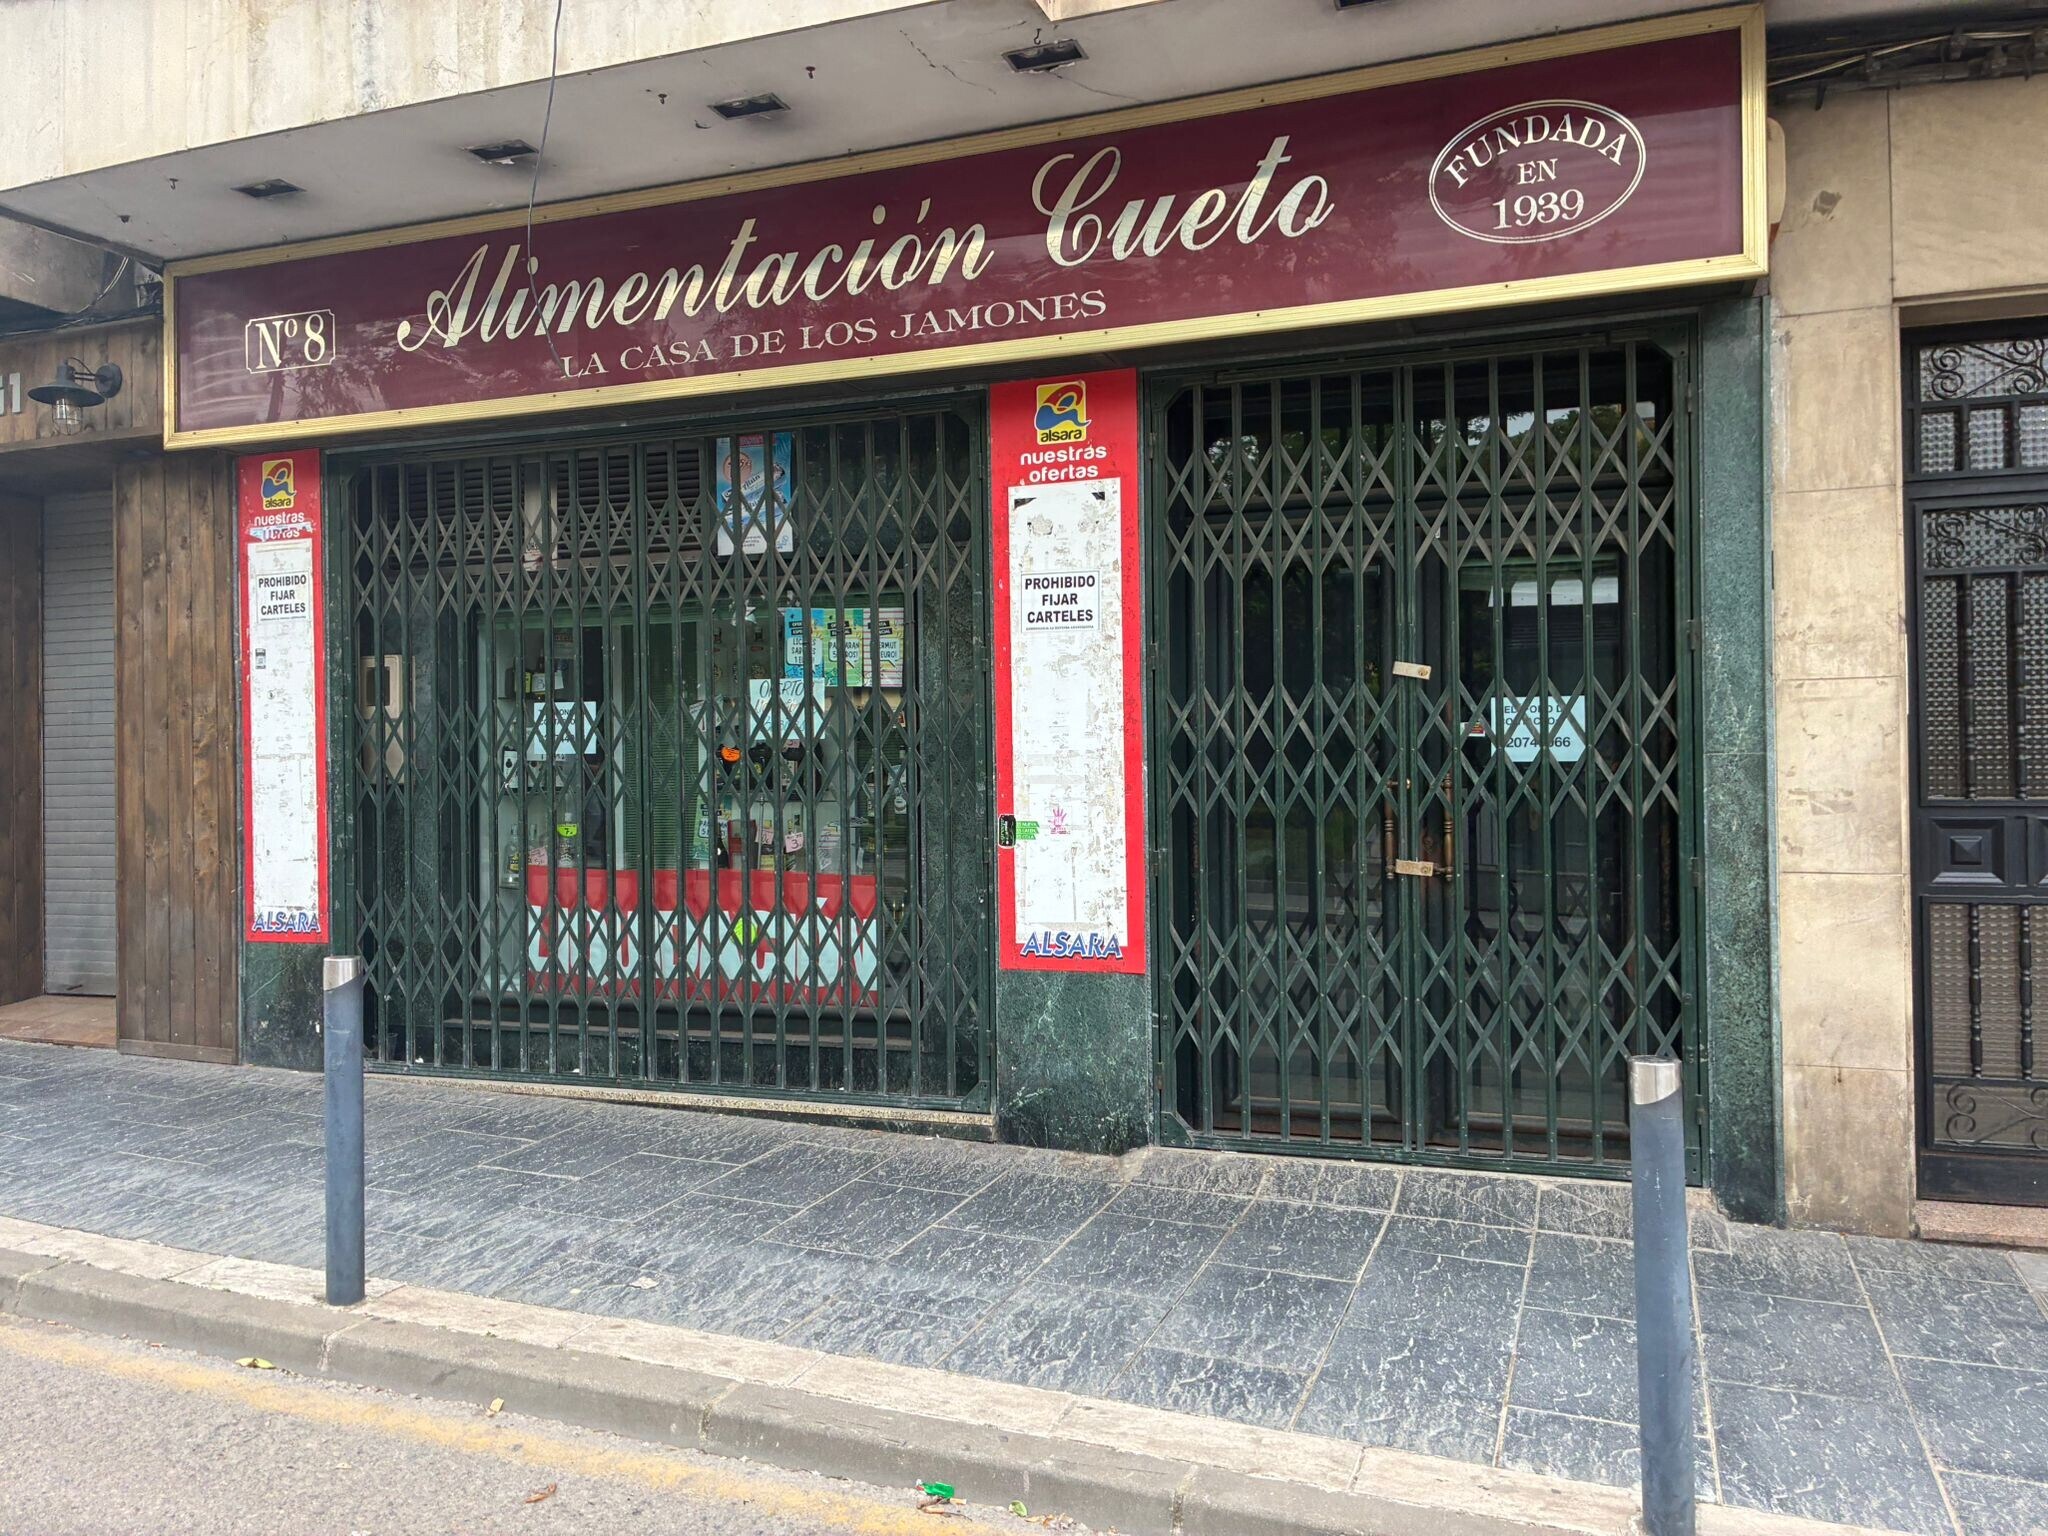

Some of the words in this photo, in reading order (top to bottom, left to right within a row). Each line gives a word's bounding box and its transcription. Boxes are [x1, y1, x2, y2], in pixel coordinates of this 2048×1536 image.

[1444, 113, 1627, 189] FUNDADA
[1517, 158, 1558, 185] EN
[1492, 188, 1585, 231] 1939
[397, 198, 994, 351] Alimentación
[1031, 135, 1335, 267] Cueto
[304, 313, 325, 362] 8
[560, 351, 608, 379] LA
[620, 340, 717, 371] CASA
[730, 328, 787, 358] DE
[799, 317, 878, 351] LOS
[890, 289, 1107, 339] JAMONES
[1040, 428, 1083, 443] alsara
[1020, 444, 1107, 466] nuestras
[1029, 462, 1099, 483] ofertas
[264, 497, 292, 508] alsara
[254, 511, 305, 526] nuestras
[258, 574, 307, 588] PROHIBIDO
[1024, 574, 1096, 590] PROHIBIDO
[270, 589, 296, 601] FIJAR
[1041, 592, 1078, 607] FIJAR
[260, 602, 306, 615] CARTELES
[1027, 609, 1094, 624] CARTELES
[252, 910, 320, 934] ALSARA
[1020, 930, 1124, 962] ALSARA
